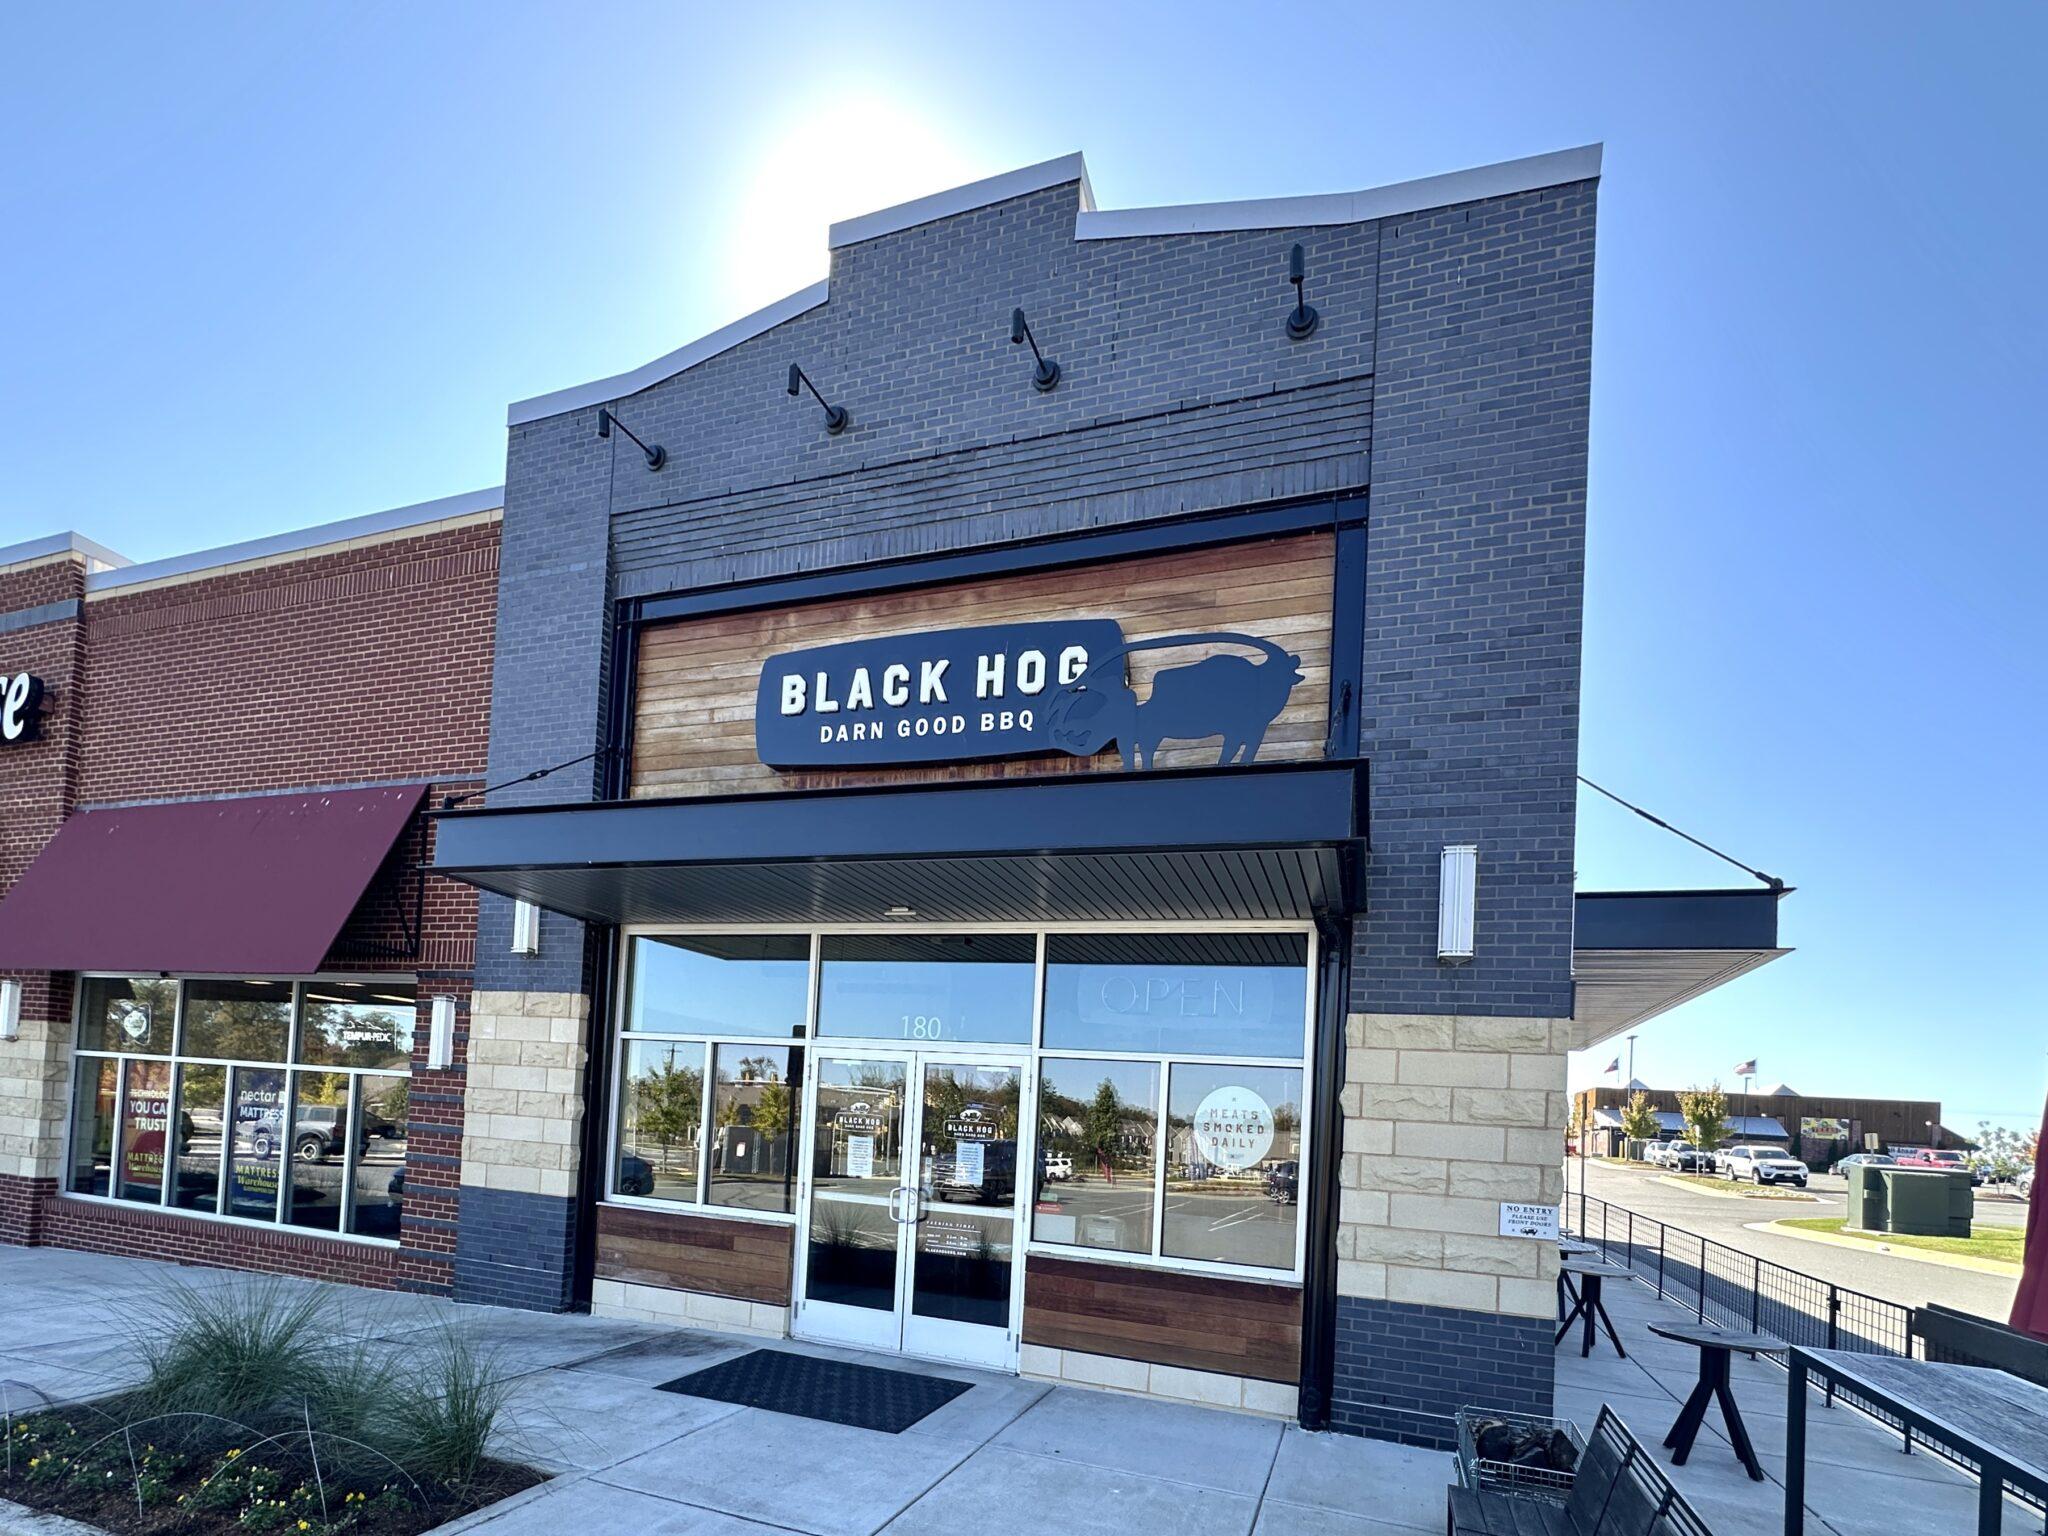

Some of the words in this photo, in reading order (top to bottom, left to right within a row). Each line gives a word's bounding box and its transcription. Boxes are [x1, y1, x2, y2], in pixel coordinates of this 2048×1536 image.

[781, 659, 950, 716] BLACK
[976, 645, 1089, 698] HOG
[820, 721, 883, 743] DARN
[897, 715, 966, 738] GOOD
[980, 709, 1034, 732] BBQ
[1101, 976, 1244, 1017] OPEN
[901, 1015, 942, 1040] 180
[240, 1089, 276, 1102] nectar
[130, 1100, 151, 1114] YOU
[152, 1101, 169, 1115] CA
[1210, 1108, 1258, 1120] MEATS
[134, 1117, 167, 1131] TRUST
[947, 1124, 974, 1133] BLACK
[1203, 1122, 1264, 1134] SMOKED
[1211, 1136, 1255, 1148] DAILY
[236, 1164, 280, 1178] MATTRES
